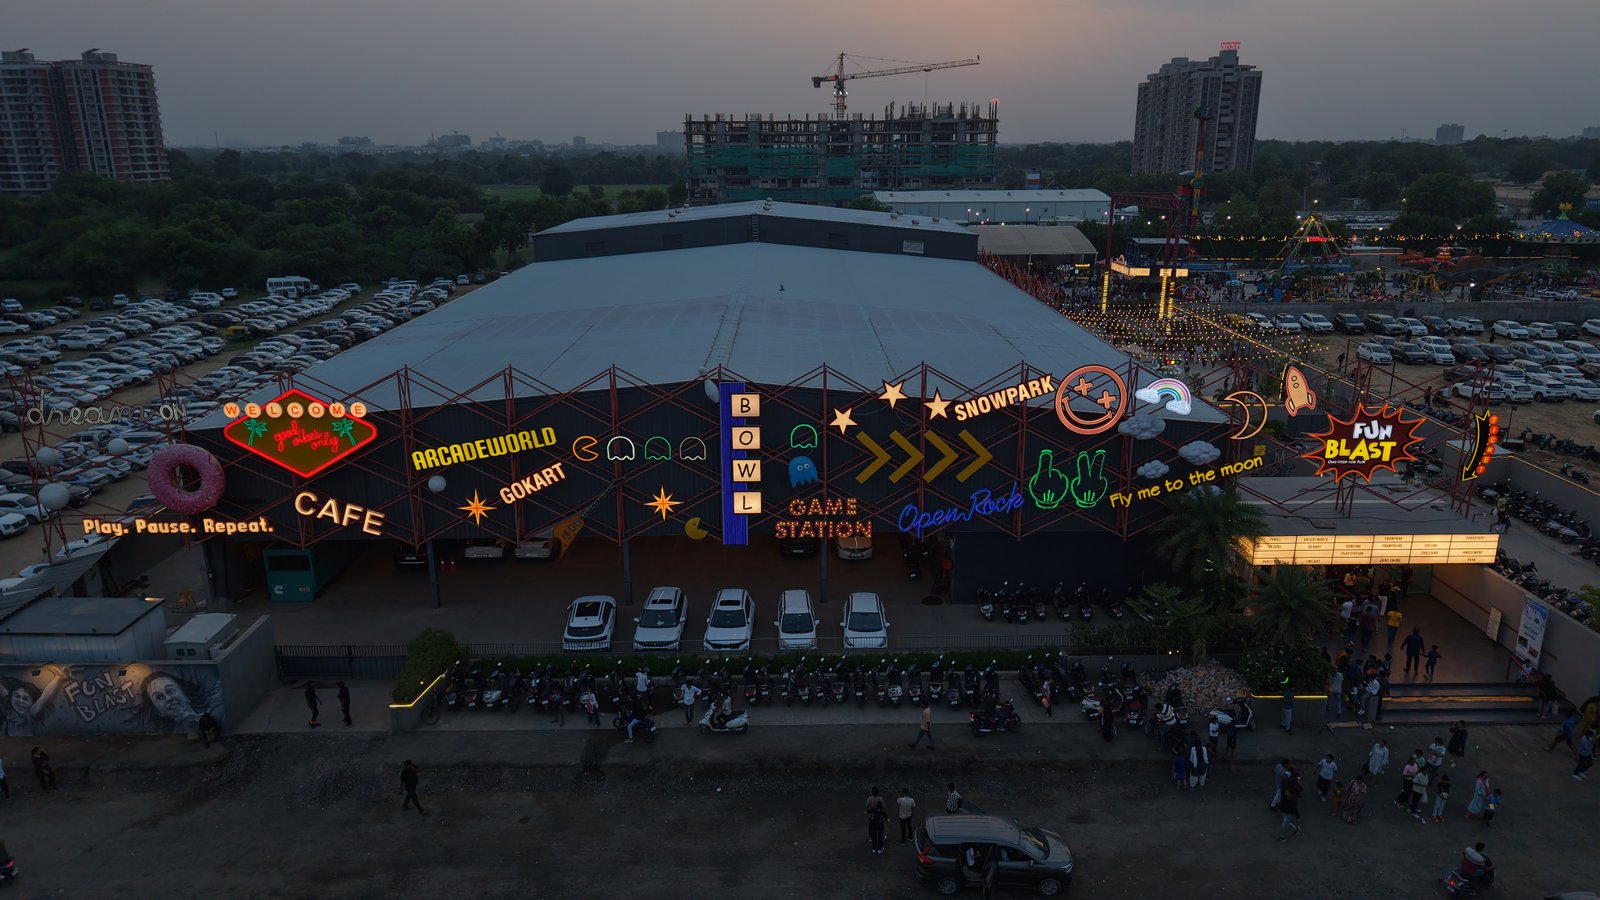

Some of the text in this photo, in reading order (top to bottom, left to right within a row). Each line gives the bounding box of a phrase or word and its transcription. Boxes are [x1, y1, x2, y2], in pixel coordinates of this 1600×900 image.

[26, 388, 187, 426] dream ON
[225, 404, 365, 416] WELCOME
[954, 374, 1055, 421] SNOWPARK
[273, 420, 339, 453] good vibes only
[411, 427, 557, 471] ARCADEWORLD
[1325, 438, 1397, 461] BLAST
[1352, 419, 1393, 440] FUN
[1477, 416, 1498, 473] TICKET
[735, 396, 758, 513] BOWL
[500, 462, 567, 505] GOKART
[1108, 456, 1264, 508] Fly me to the moon
[83, 516, 274, 537] Play. Pause. Repeat.
[294, 491, 386, 536] CAFE
[788, 498, 857, 516] GAME
[898, 480, 1025, 539] Open Rock
[775, 520, 873, 539] STATION
[64, 672, 114, 704] FUN
[76, 680, 136, 722] BLAST
